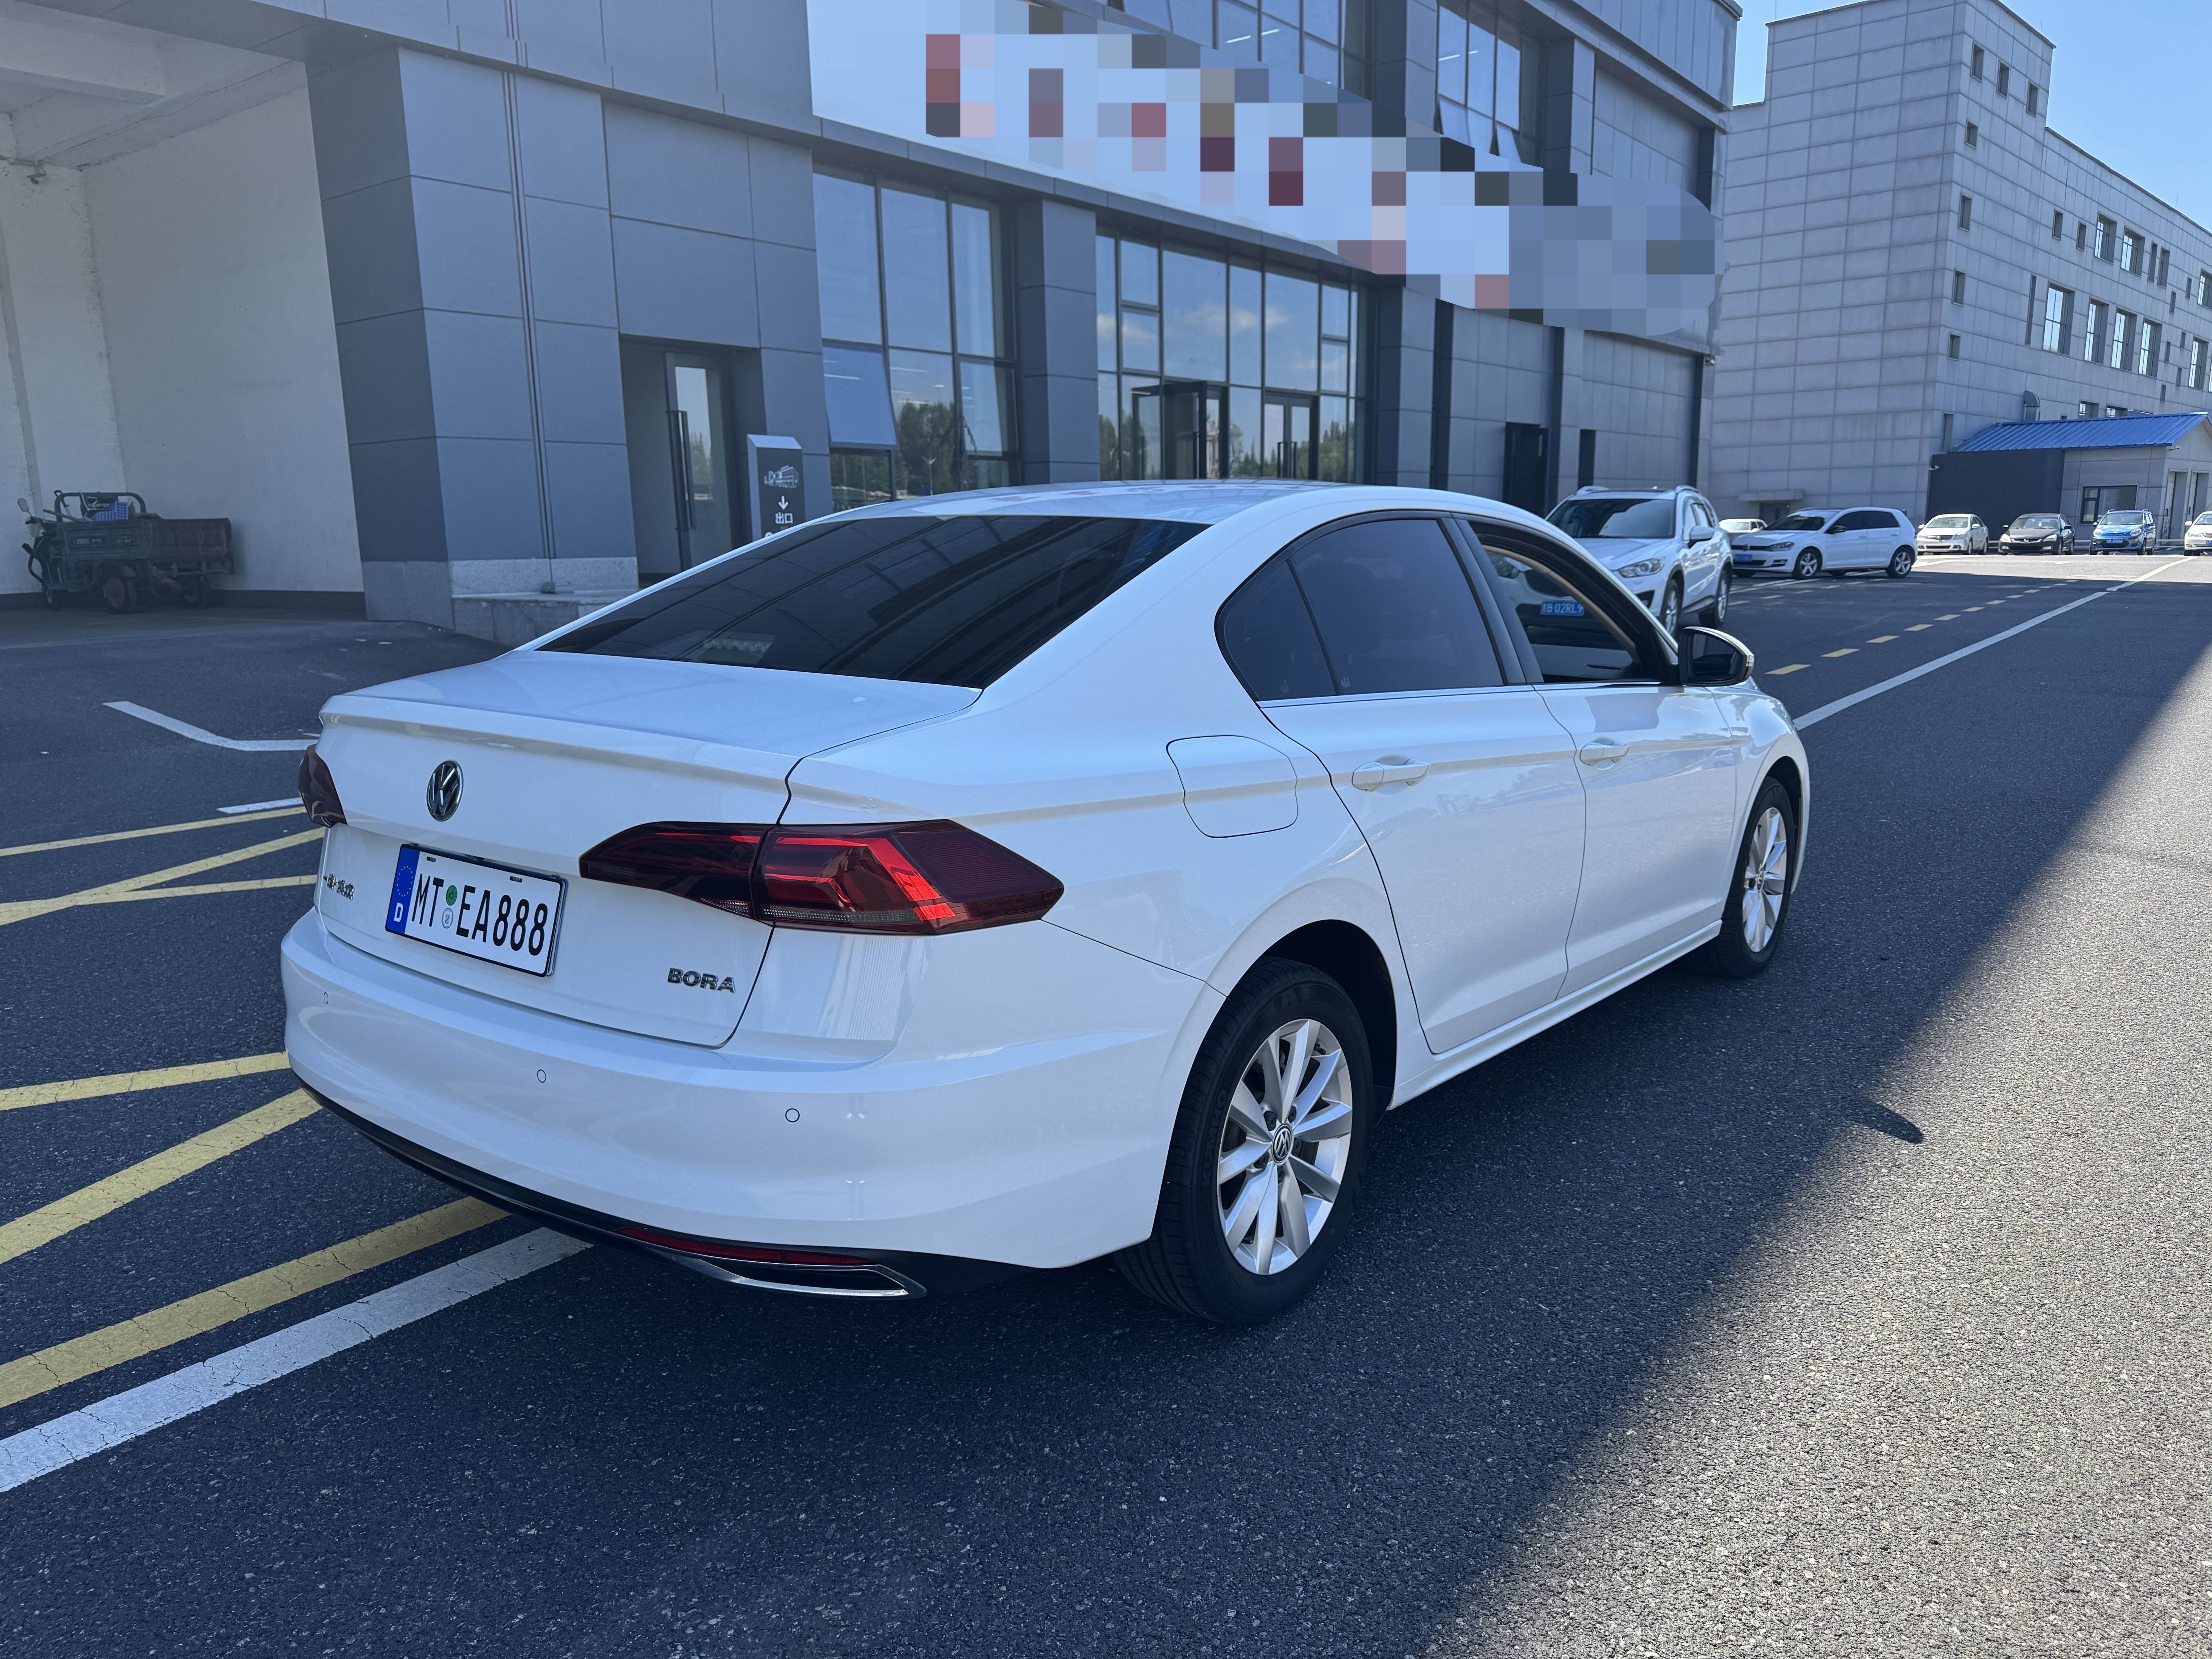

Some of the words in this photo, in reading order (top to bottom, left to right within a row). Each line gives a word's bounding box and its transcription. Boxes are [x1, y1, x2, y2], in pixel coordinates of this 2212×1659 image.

[775, 512, 793, 524] 出口
[393, 902, 404, 922] D
[411, 873, 445, 927] MT
[456, 884, 548, 956] EA888
[667, 968, 736, 993] BORA
[1202, 1090, 1228, 1188] KUMHO
